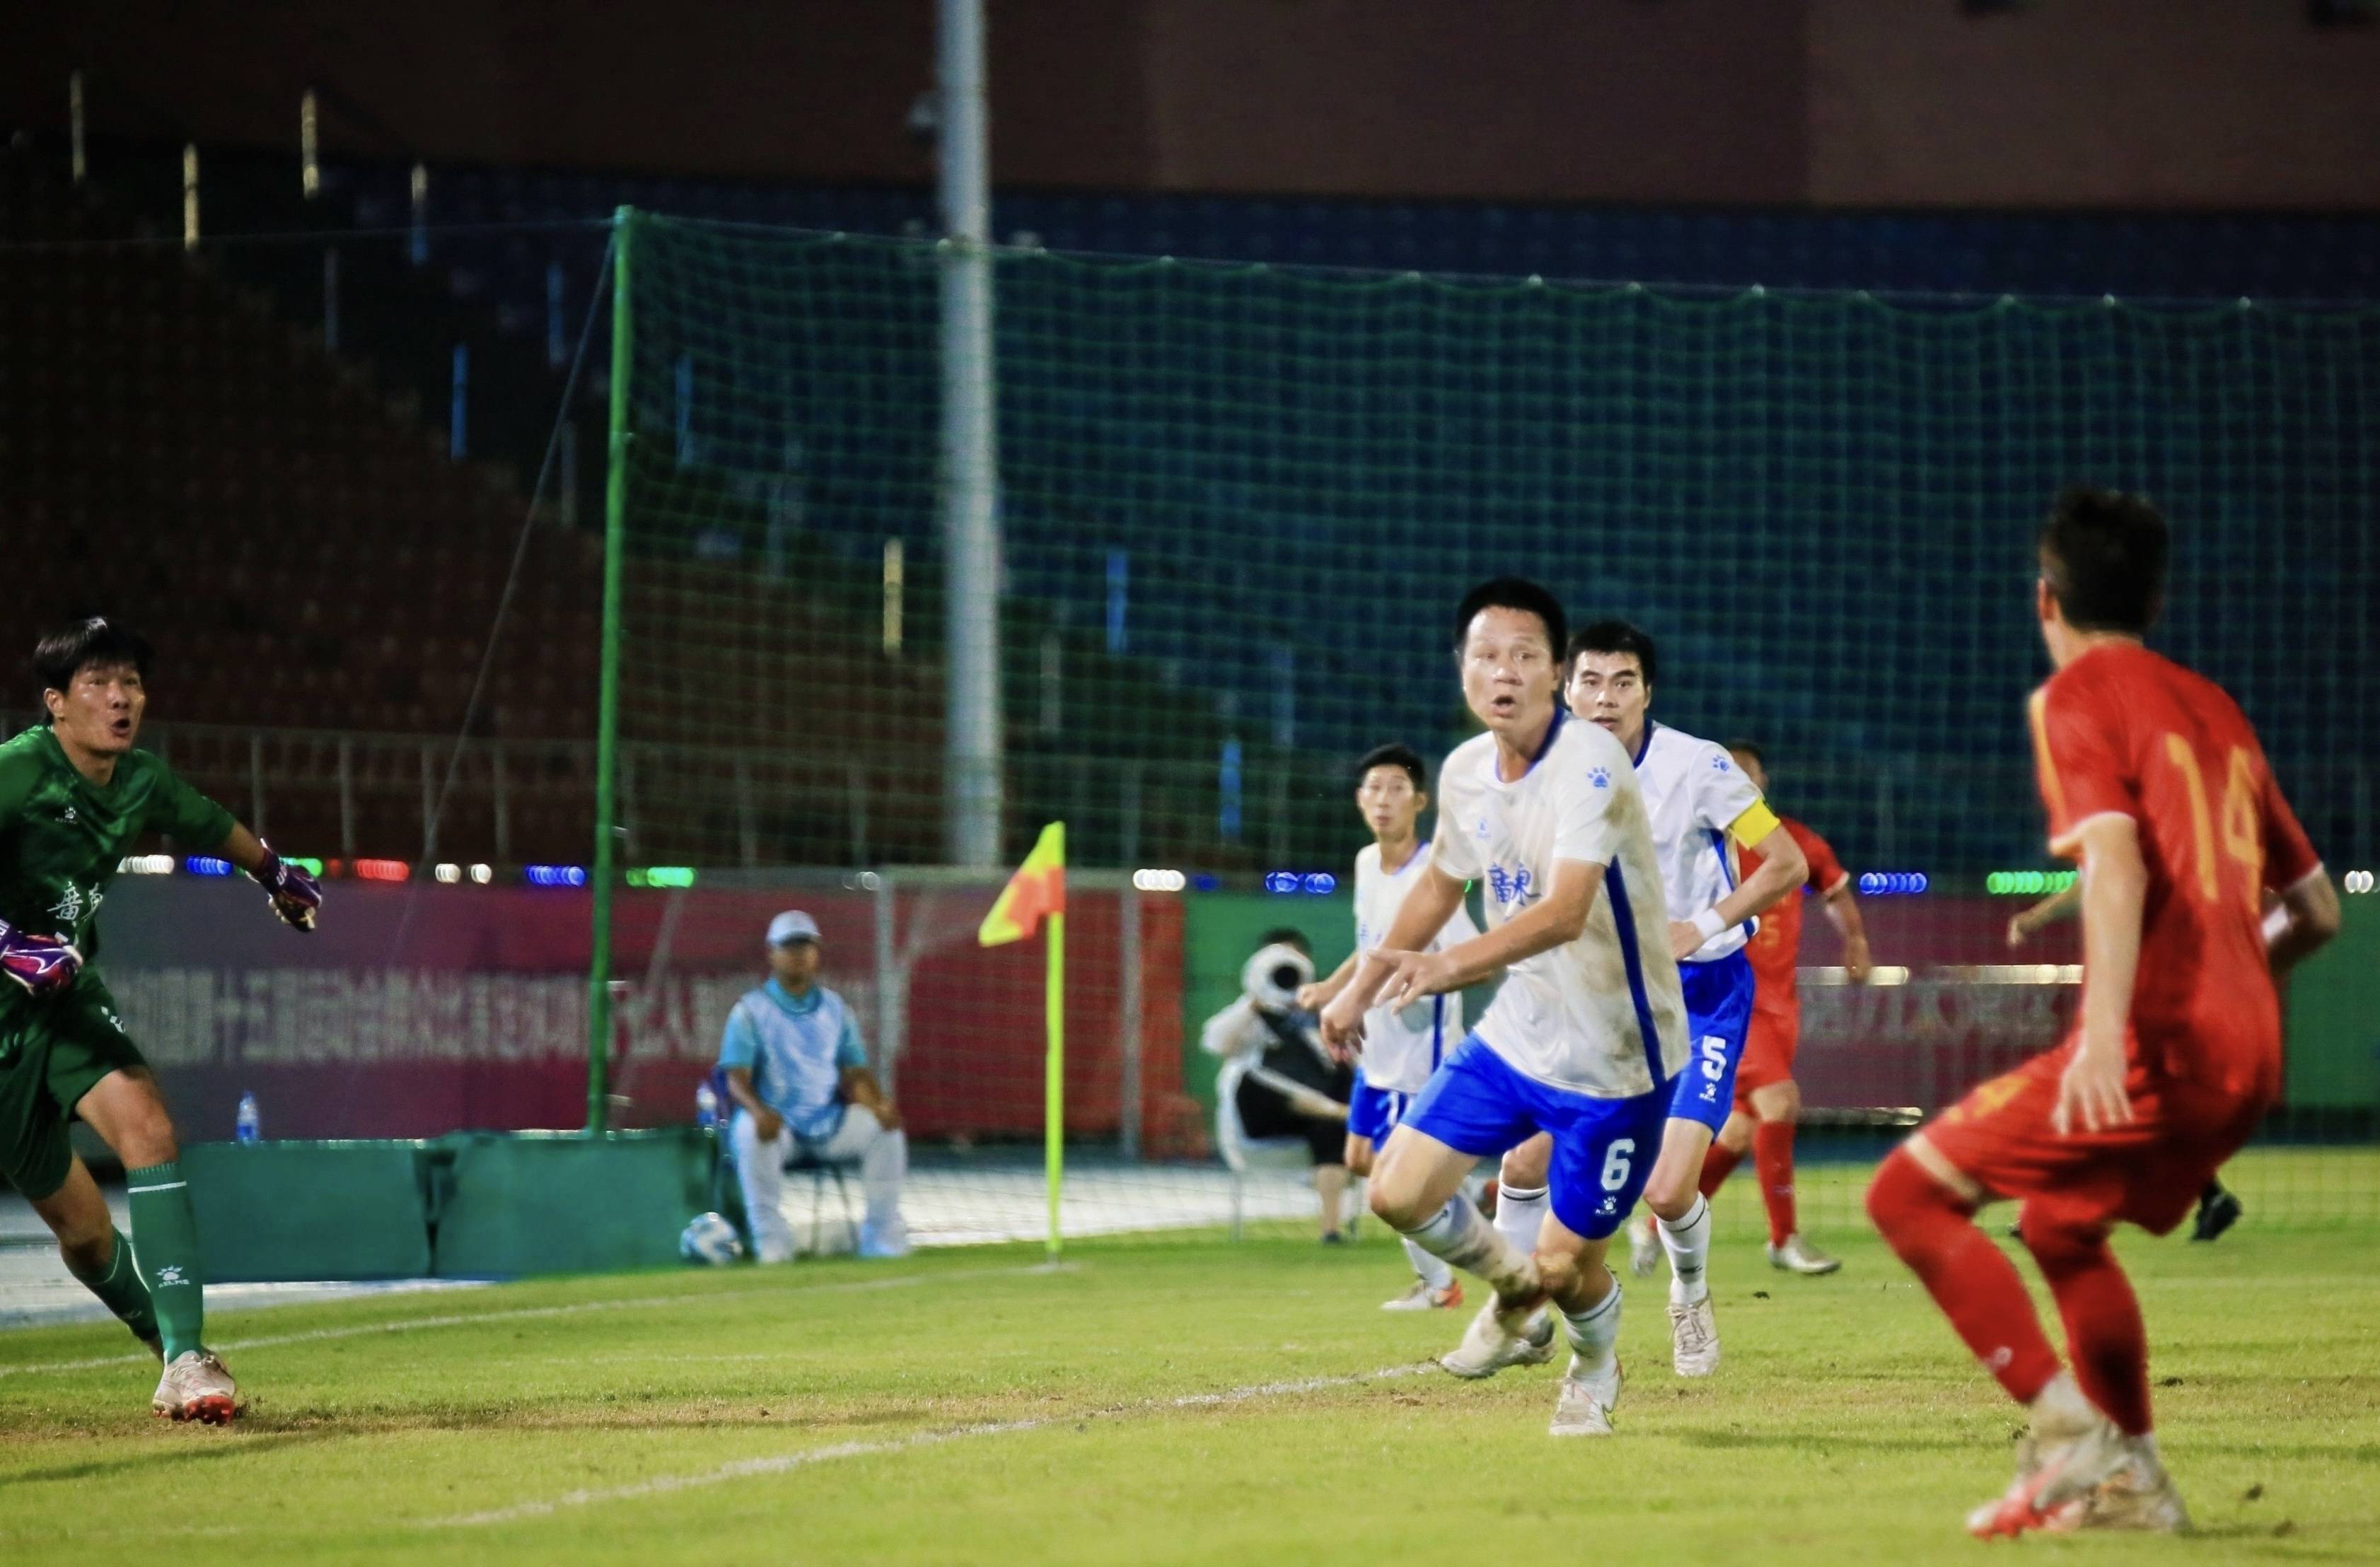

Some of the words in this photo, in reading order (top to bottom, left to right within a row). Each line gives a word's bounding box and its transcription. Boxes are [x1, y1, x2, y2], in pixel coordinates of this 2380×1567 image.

[2166, 731, 2262, 914] 14
[1702, 1035, 1726, 1082] 5
[1601, 1138, 1635, 1191] 6
